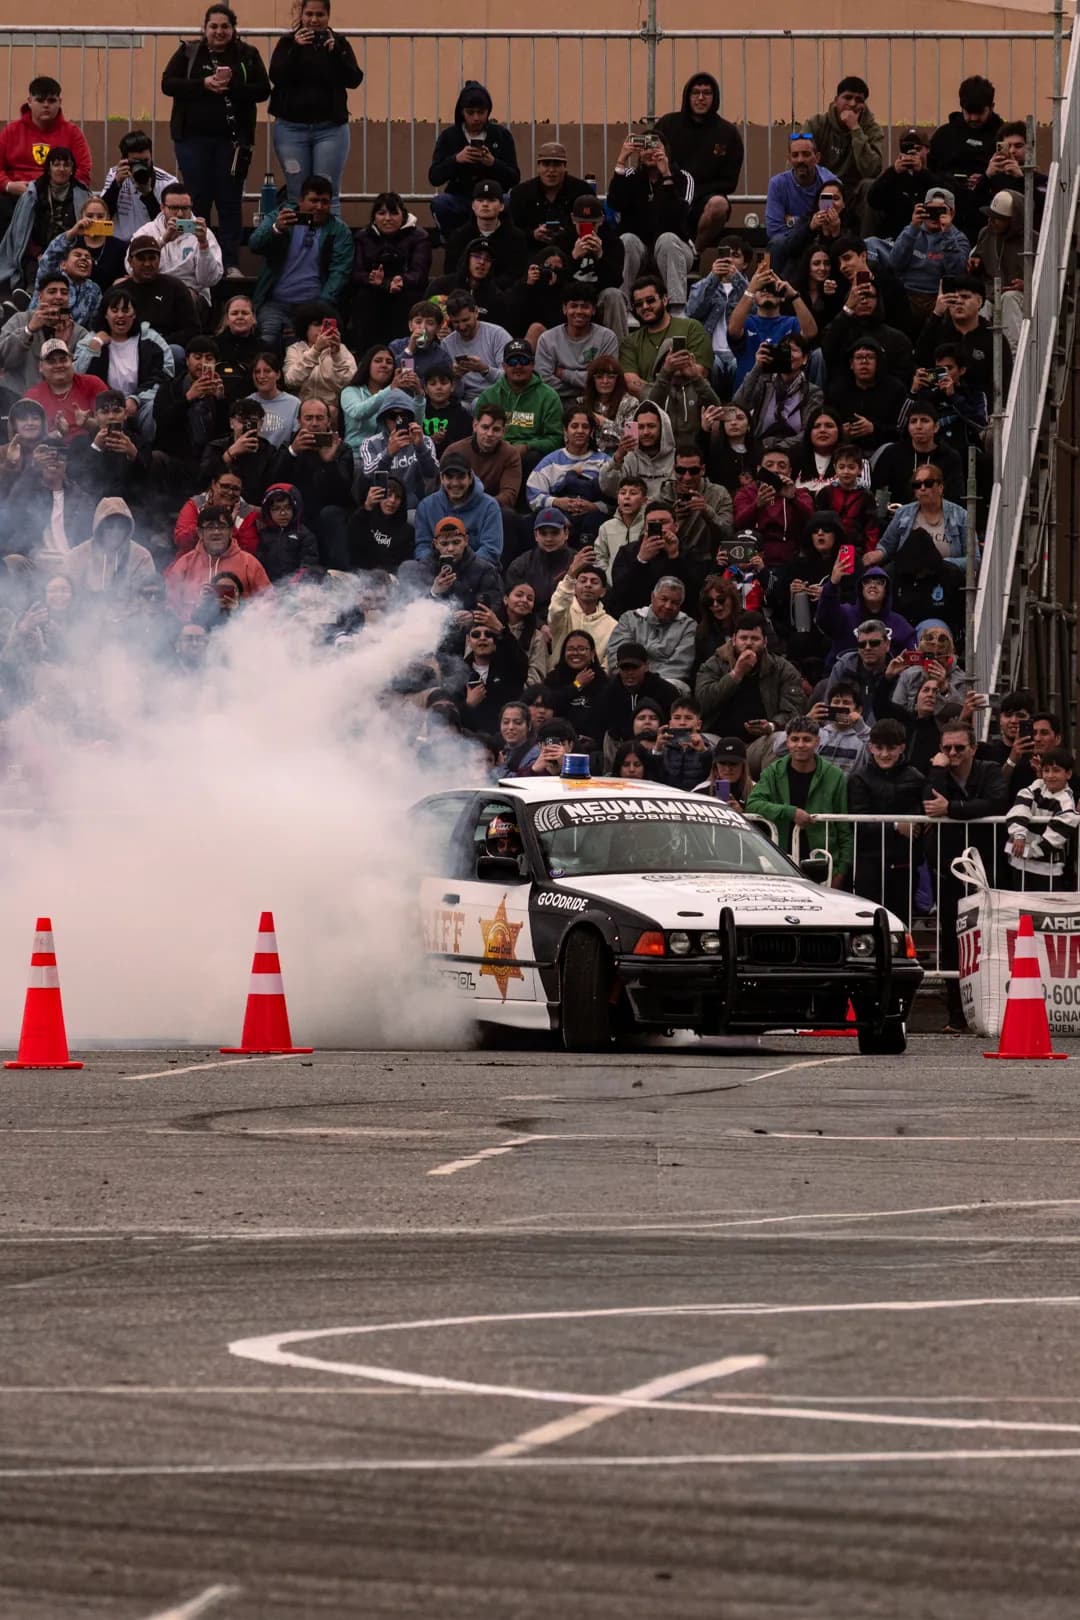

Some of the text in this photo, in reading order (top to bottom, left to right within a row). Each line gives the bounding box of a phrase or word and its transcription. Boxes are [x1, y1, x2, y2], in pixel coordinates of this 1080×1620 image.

[563, 799, 746, 825] NEUMAMUNDO
[571, 814, 619, 825] TODO
[624, 813, 682, 822] SOBRE
[537, 892, 589, 912] GOODRIDE
